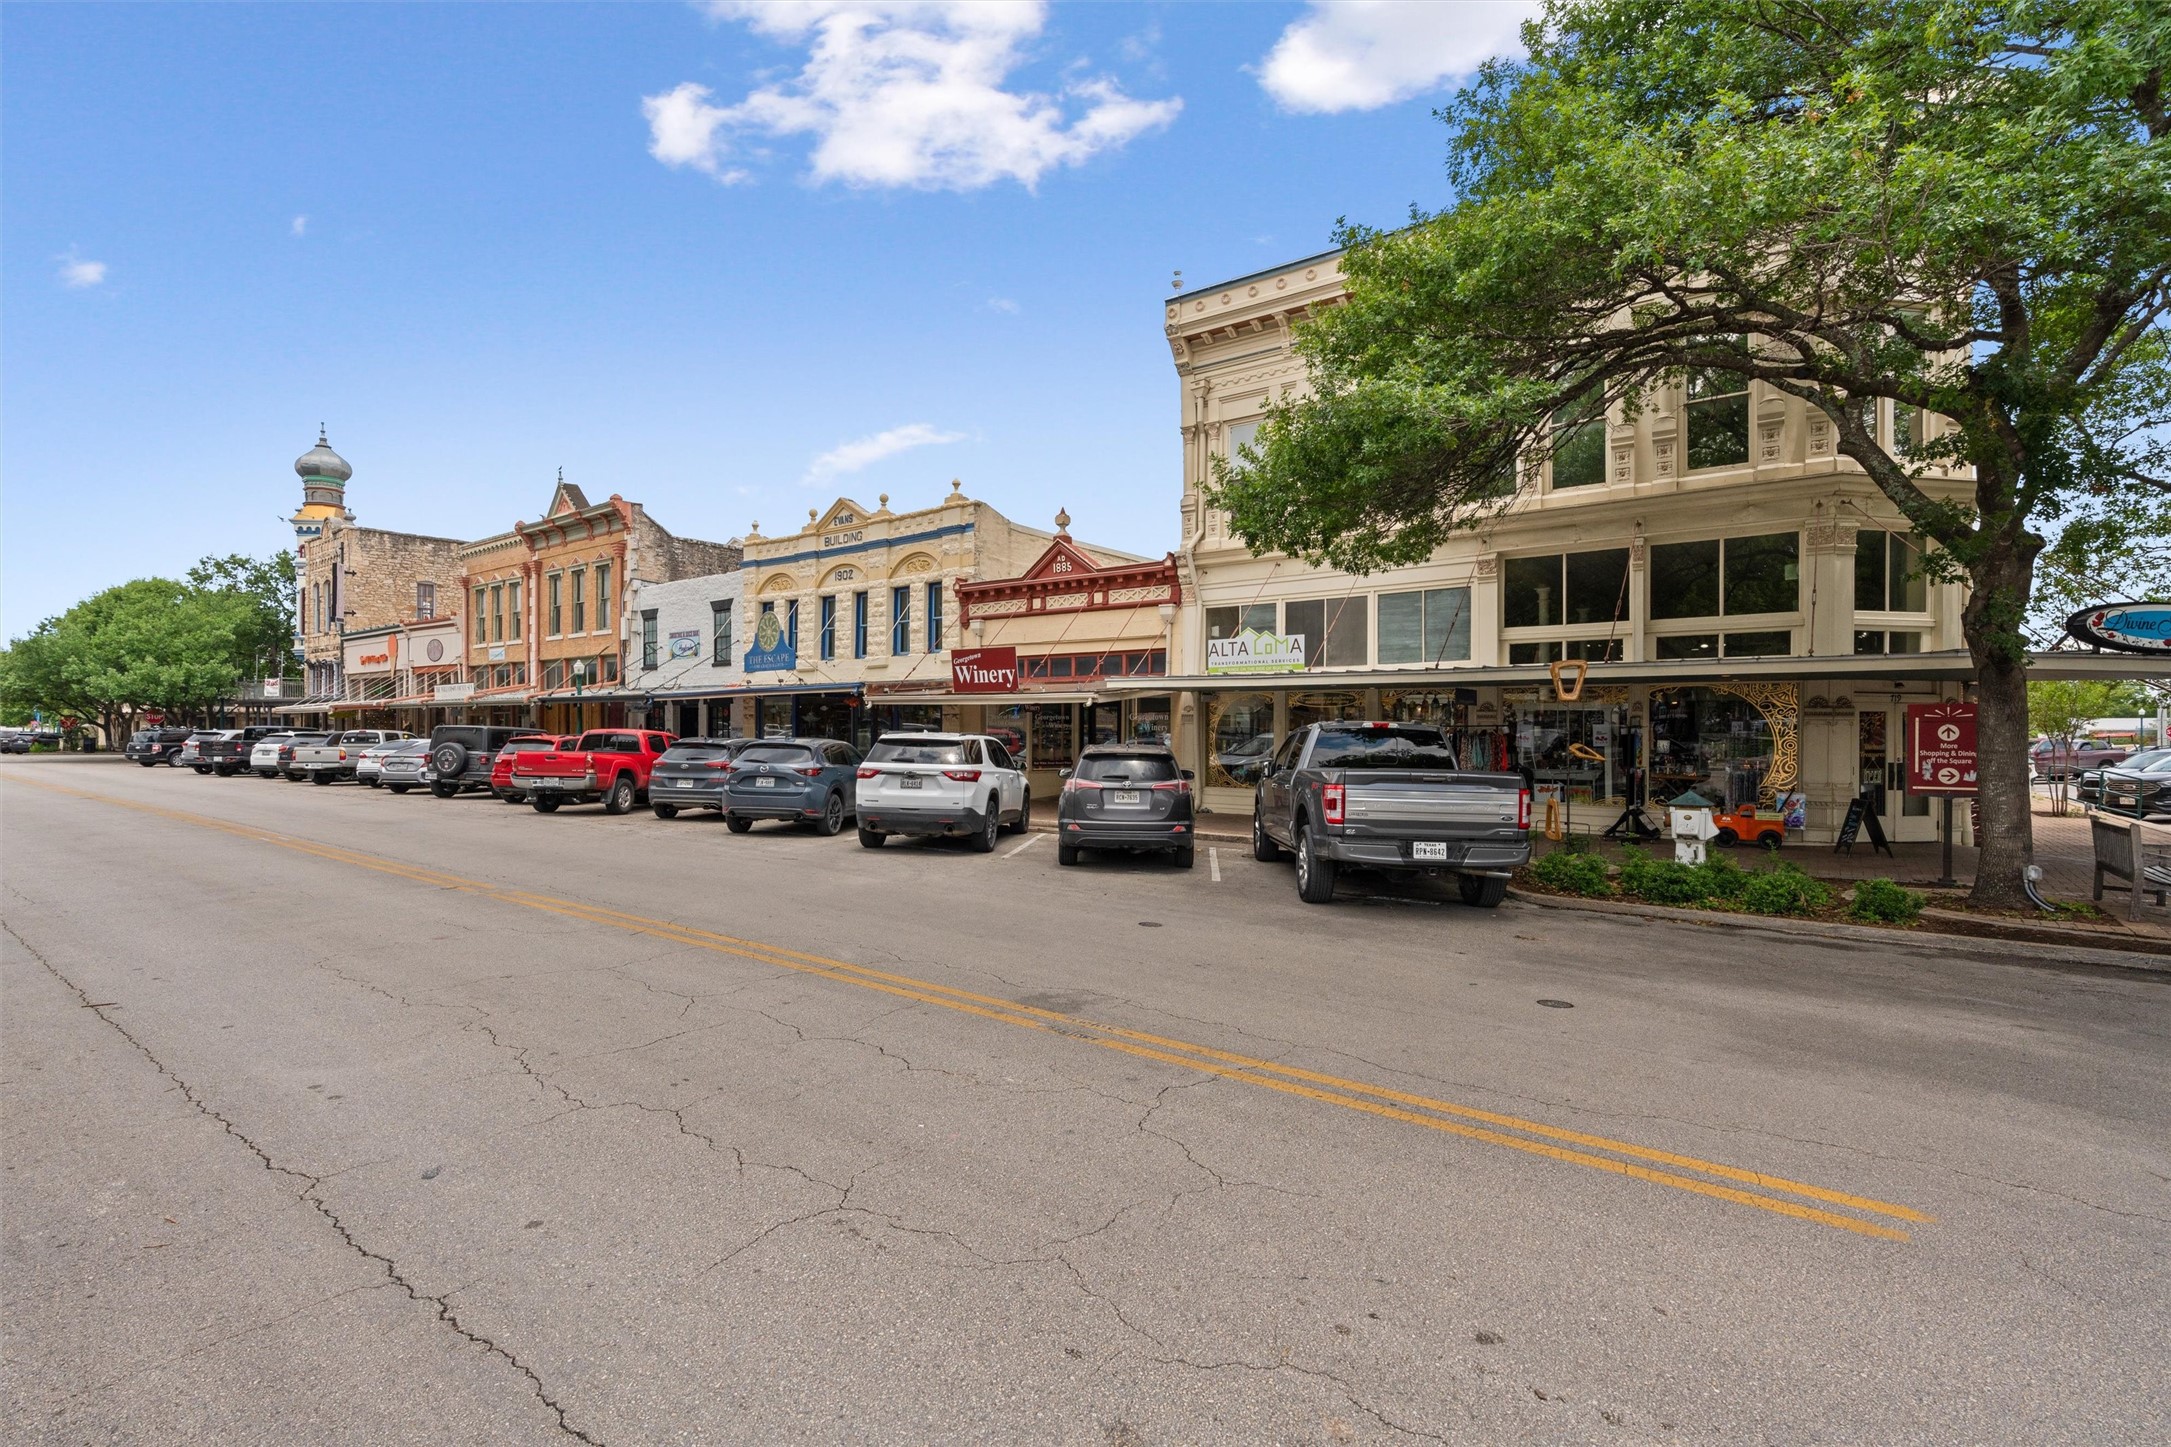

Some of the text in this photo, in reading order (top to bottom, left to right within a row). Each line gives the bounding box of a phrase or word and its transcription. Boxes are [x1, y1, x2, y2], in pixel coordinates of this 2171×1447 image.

[833, 514, 853, 526] EVANS
[825, 531, 862, 547] BUILDING
[1053, 562, 1072, 573] 1885
[834, 569, 853, 581] 1902
[2097, 608, 2157, 631] Divine
[1208, 641, 1249, 657] ALTA
[750, 653, 789, 664] THE ESCAPE
[953, 653, 981, 664] Georgetown
[954, 664, 1015, 688] Winery
